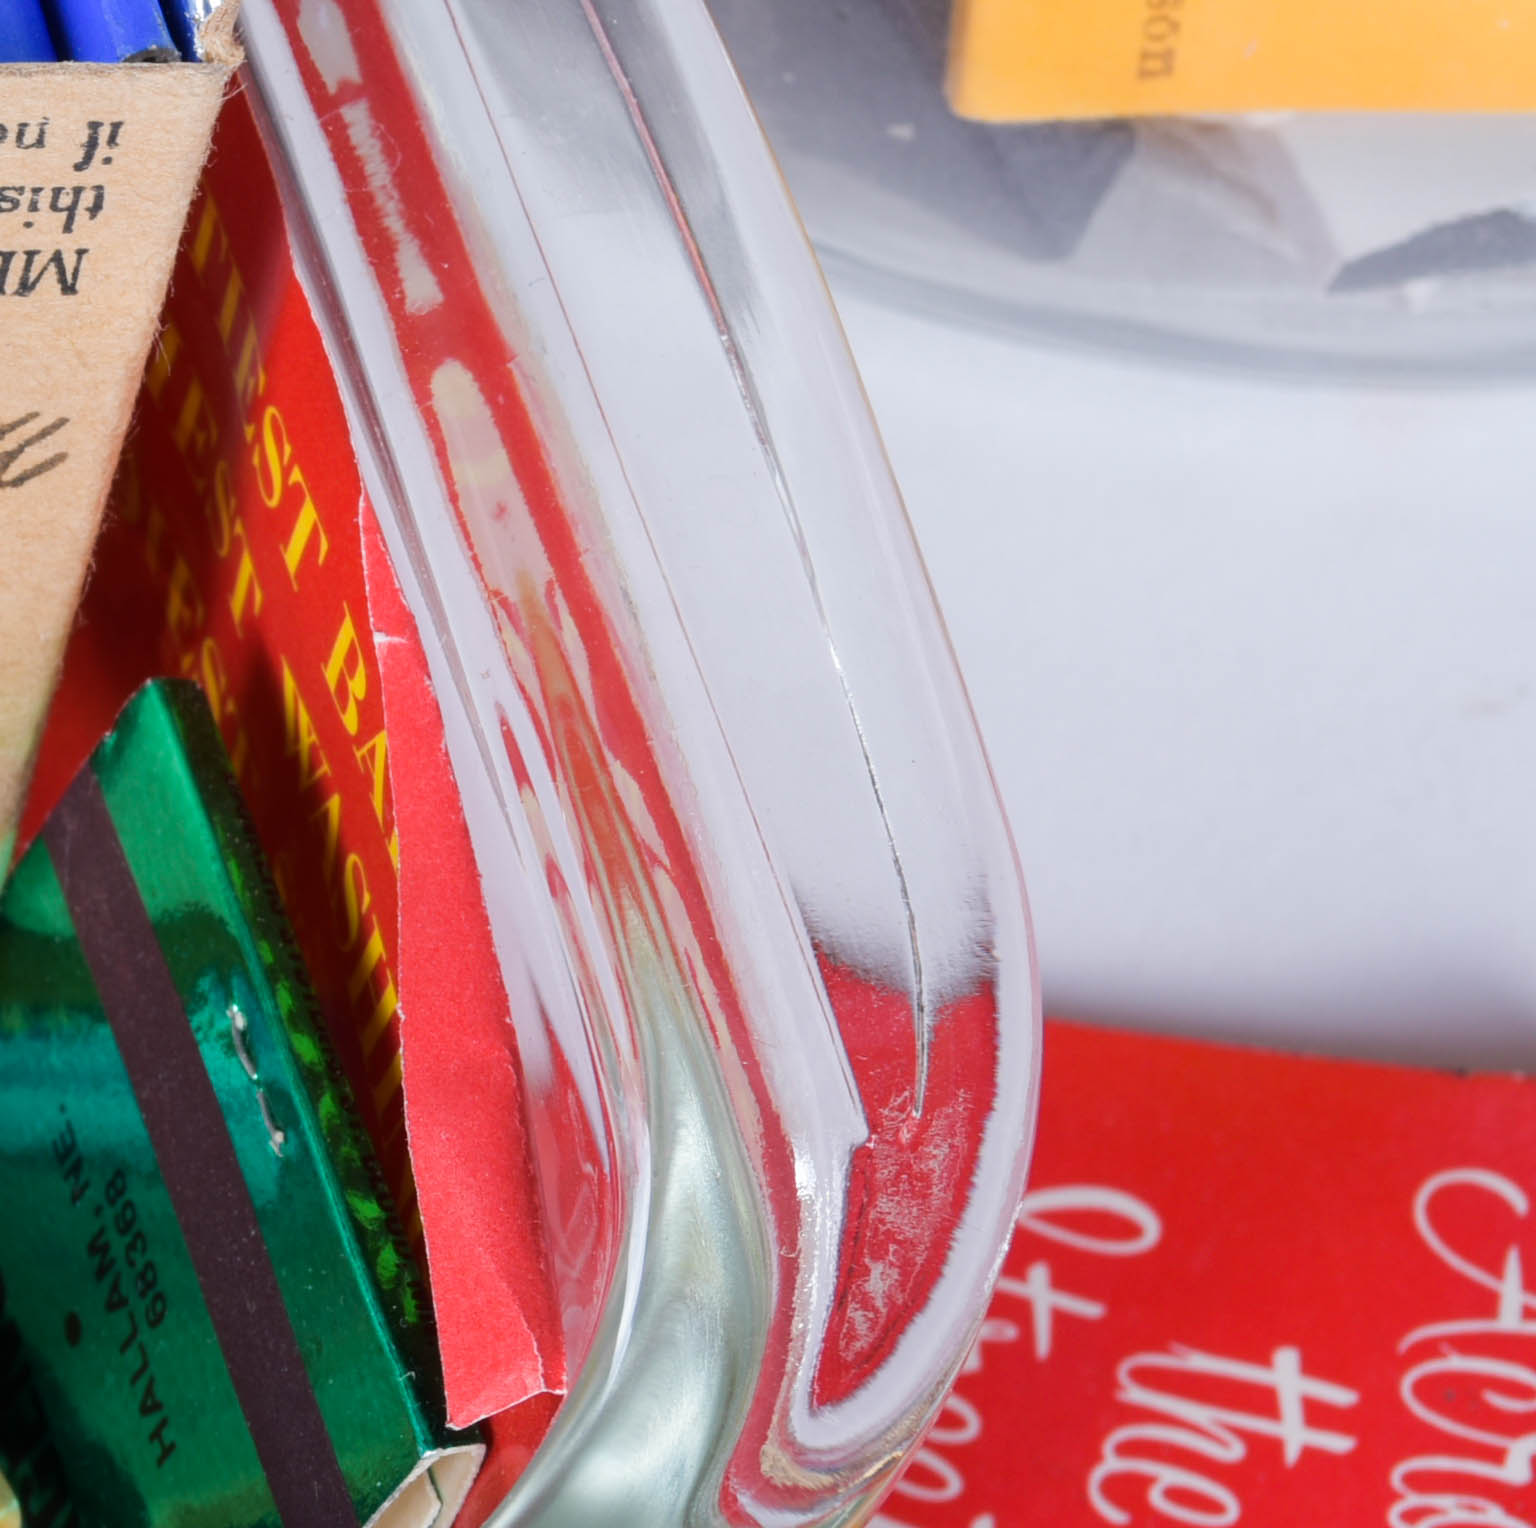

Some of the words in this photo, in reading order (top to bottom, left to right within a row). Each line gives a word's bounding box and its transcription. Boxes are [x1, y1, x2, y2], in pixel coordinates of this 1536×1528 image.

[72, 119, 125, 173] if
[323, 600, 400, 874] BA
[51, 1103, 92, 1207] NE.
[104, 1167, 169, 1330] 68368
[1086, 1340, 1359, 1528] the
